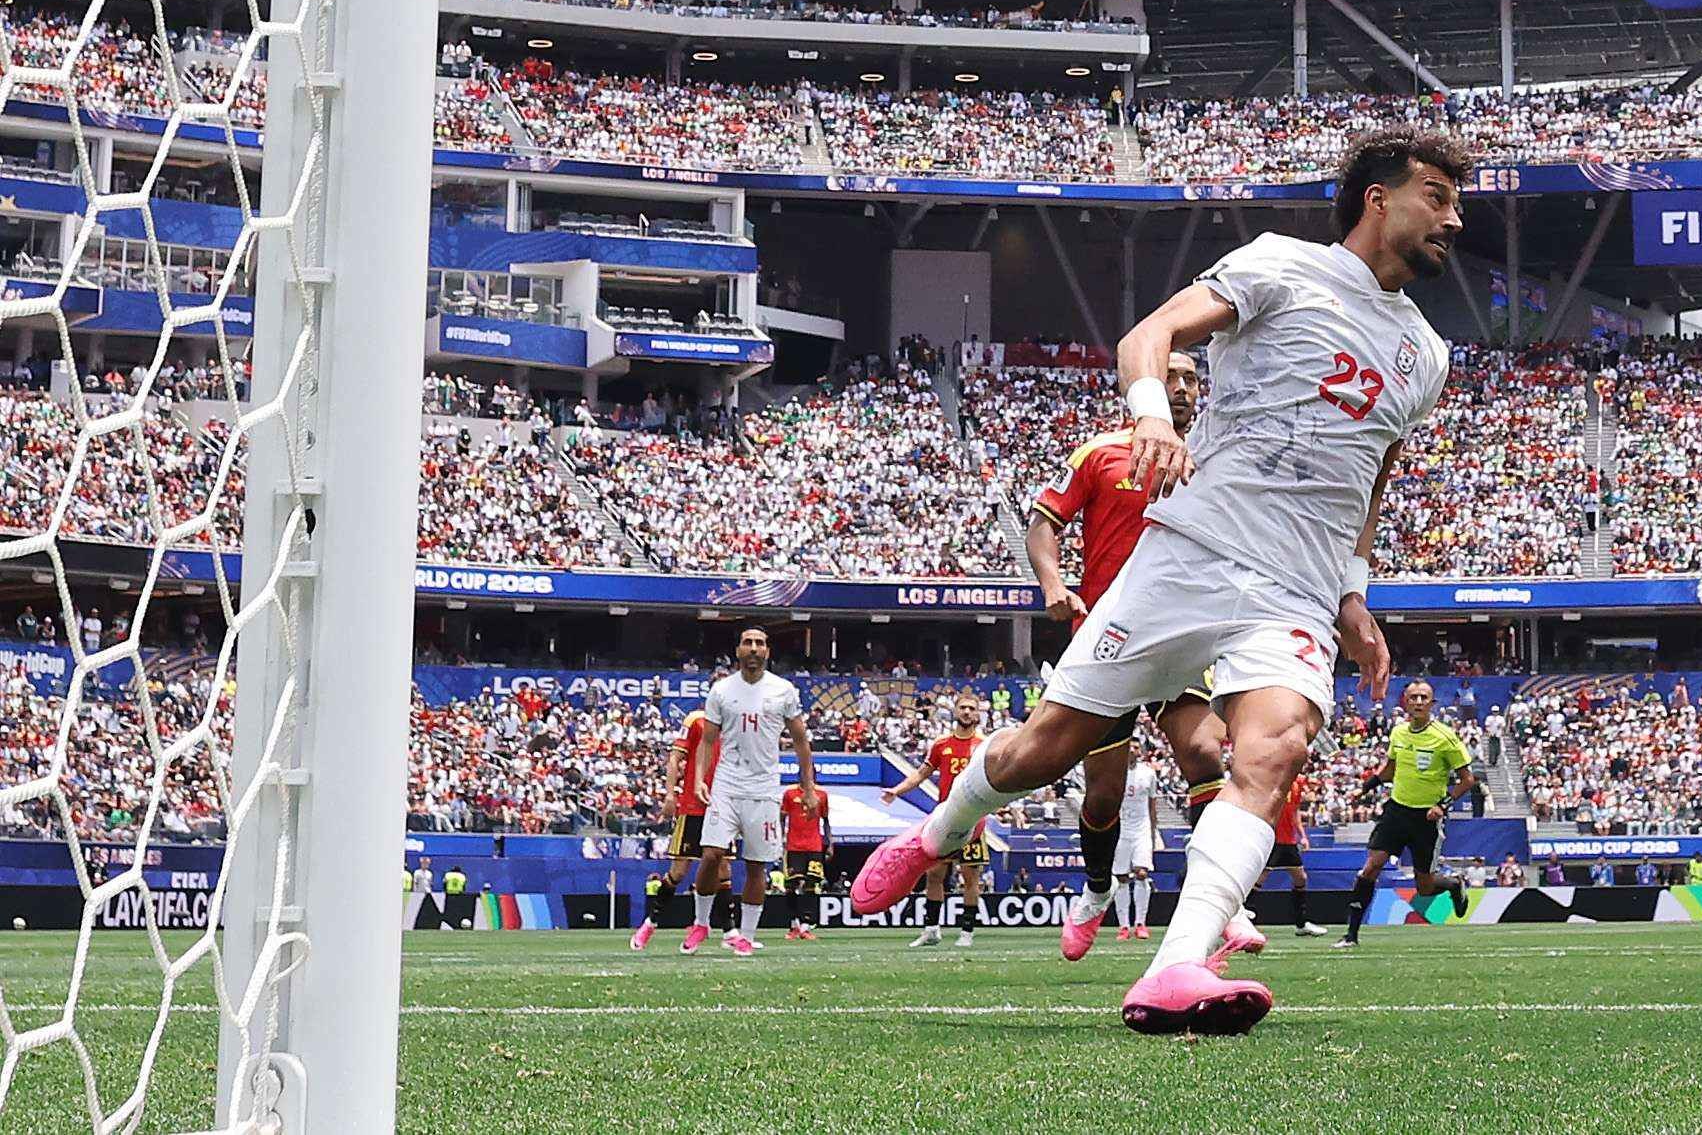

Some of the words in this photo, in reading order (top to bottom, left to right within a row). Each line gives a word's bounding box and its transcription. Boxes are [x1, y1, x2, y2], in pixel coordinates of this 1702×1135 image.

[1318, 351, 1385, 422] 23
[415, 569, 449, 588] RLD
[450, 571, 487, 591] CUP
[487, 573, 554, 594] 2026
[898, 587, 938, 605] LOS
[942, 588, 1034, 606] ANGELES
[493, 676, 555, 696] LOS
[741, 712, 758, 733] 14
[1531, 842, 1553, 855] IFA
[1553, 842, 1603, 855] WORLD
[1603, 841, 1631, 854] CUP
[1036, 855, 1065, 867] LOS
